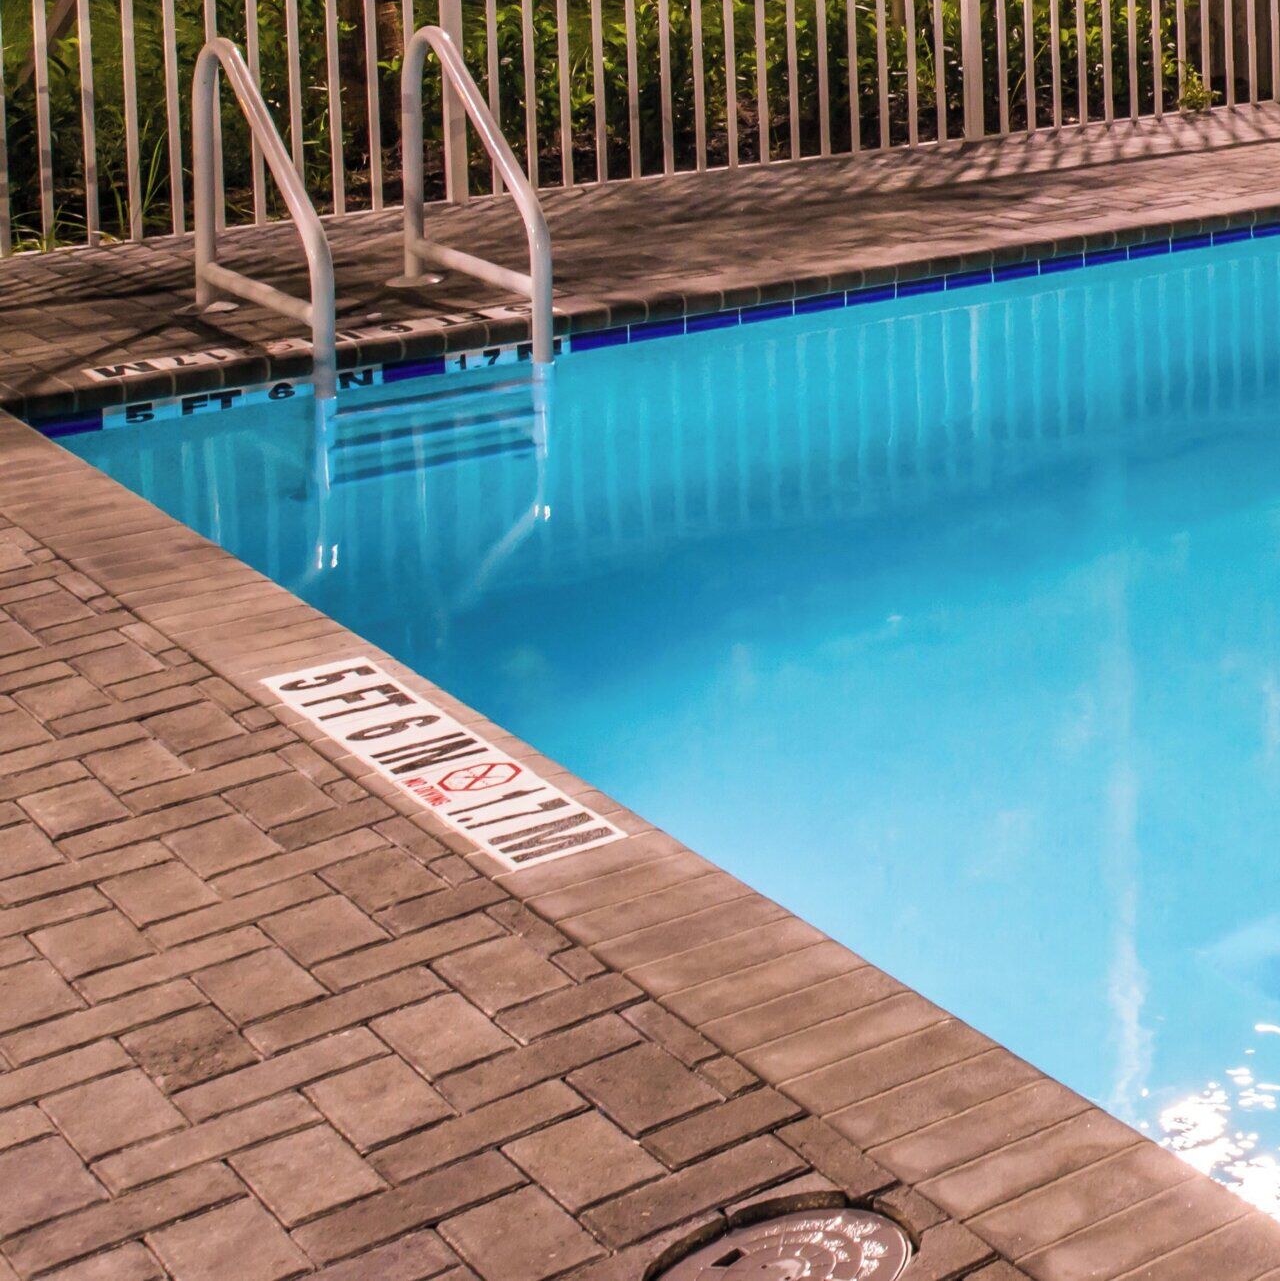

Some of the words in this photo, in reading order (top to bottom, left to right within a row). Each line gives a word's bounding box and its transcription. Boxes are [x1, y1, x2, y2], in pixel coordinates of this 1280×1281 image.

[454, 348, 501, 371] 1.7
[126, 402, 155, 424] 5
[181, 389, 243, 416] FT
[267, 381, 296, 401] 6
[278, 665, 378, 692] 5
[300, 682, 418, 721] FT
[345, 714, 442, 742] 6
[370, 731, 490, 776] IN
